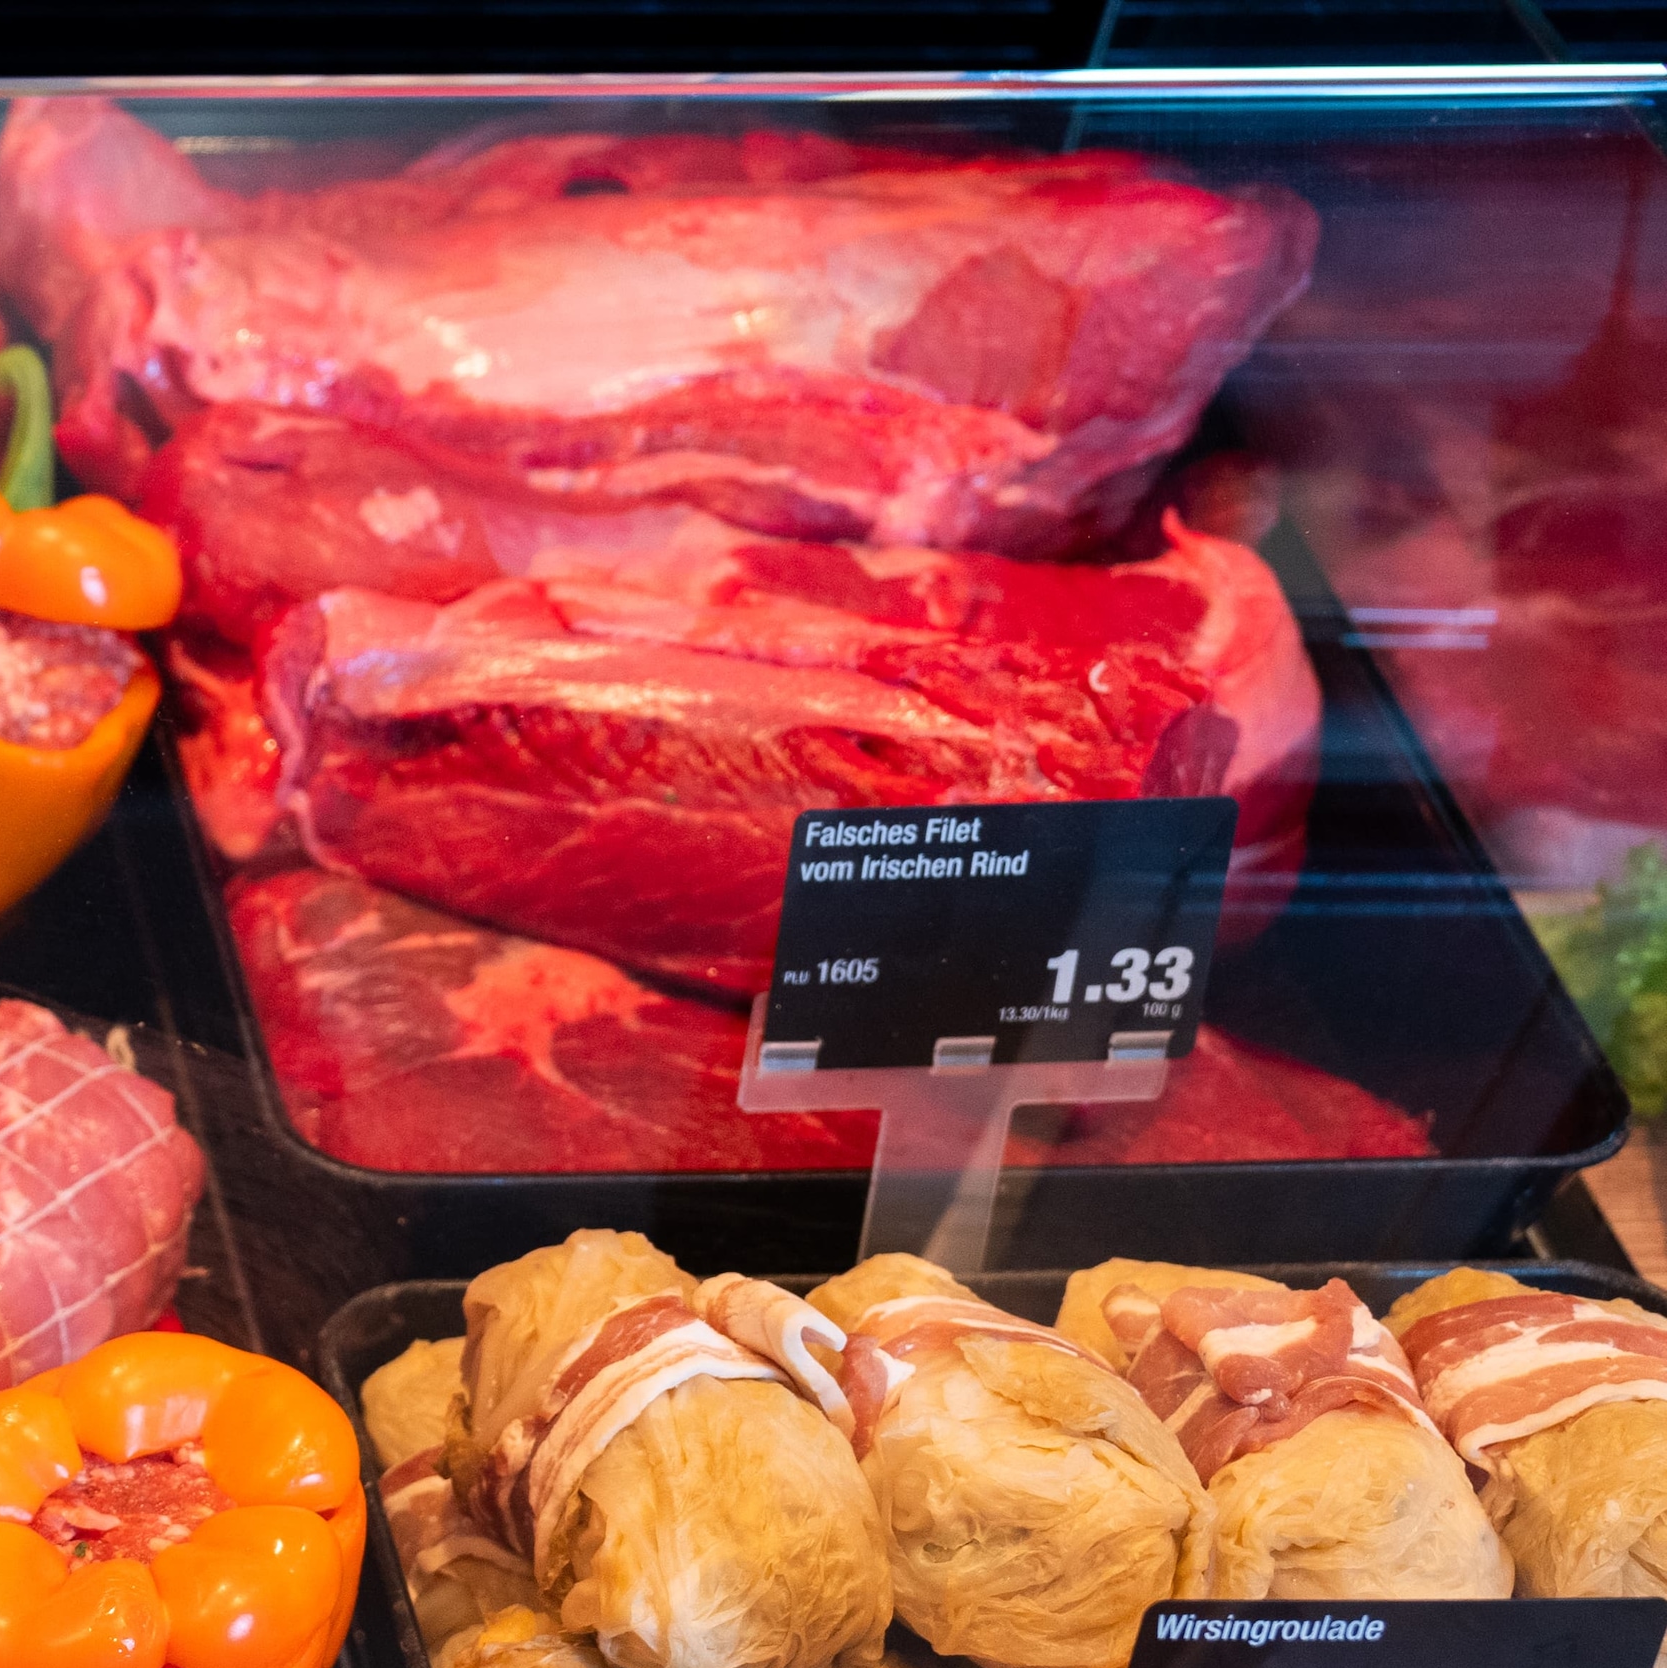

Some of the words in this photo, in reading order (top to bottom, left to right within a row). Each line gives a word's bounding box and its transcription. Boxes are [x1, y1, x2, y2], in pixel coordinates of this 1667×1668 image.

[805, 821, 917, 847] Falsches
[925, 817, 981, 843] Filet
[800, 859, 854, 881] vom
[861, 853, 963, 880] Irischen
[970, 850, 1029, 877] Rind
[784, 970, 809, 984] PLU
[817, 958, 879, 984] 1605
[1047, 946, 1193, 1004] 1.33
[998, 1006, 1069, 1023] 13.30/1kg
[1142, 1002, 1167, 1017] 100
[1156, 1613, 1385, 1646] Wirsingroulade
